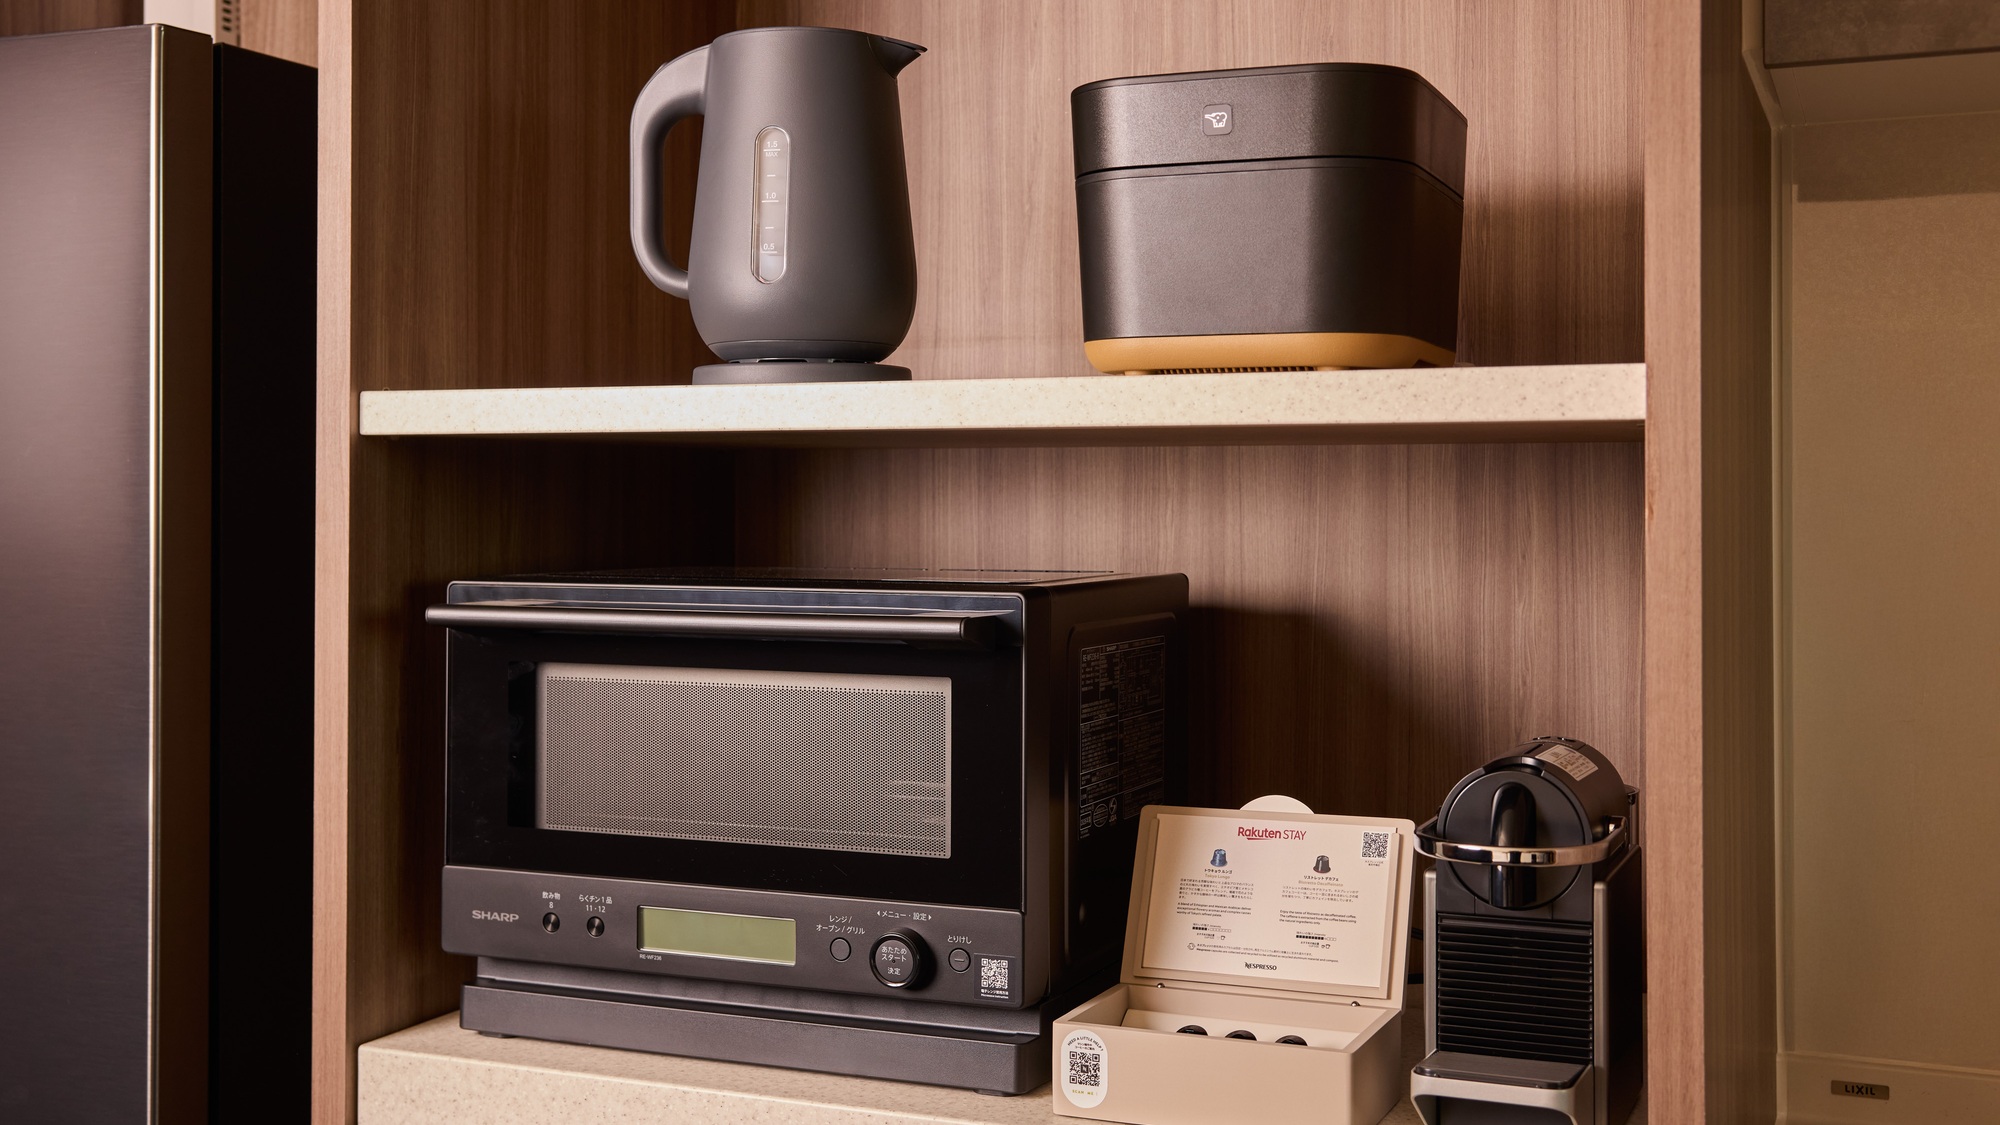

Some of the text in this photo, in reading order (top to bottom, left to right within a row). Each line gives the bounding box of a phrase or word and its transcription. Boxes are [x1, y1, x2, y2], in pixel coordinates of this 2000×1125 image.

[1238, 827, 1307, 840] Rakuten STAY
[542, 891, 561, 900] 飲み物
[549, 901, 554, 909] 8
[471, 909, 519, 923] SHARP
[947, 934, 972, 945] とりけし
[881, 946, 907, 955] あたため
[881, 954, 906, 962] スタート
[888, 966, 901, 975] 決定
[1244, 962, 1277, 971] NESPRESSO
[1844, 1084, 1876, 1096] LIXIL
